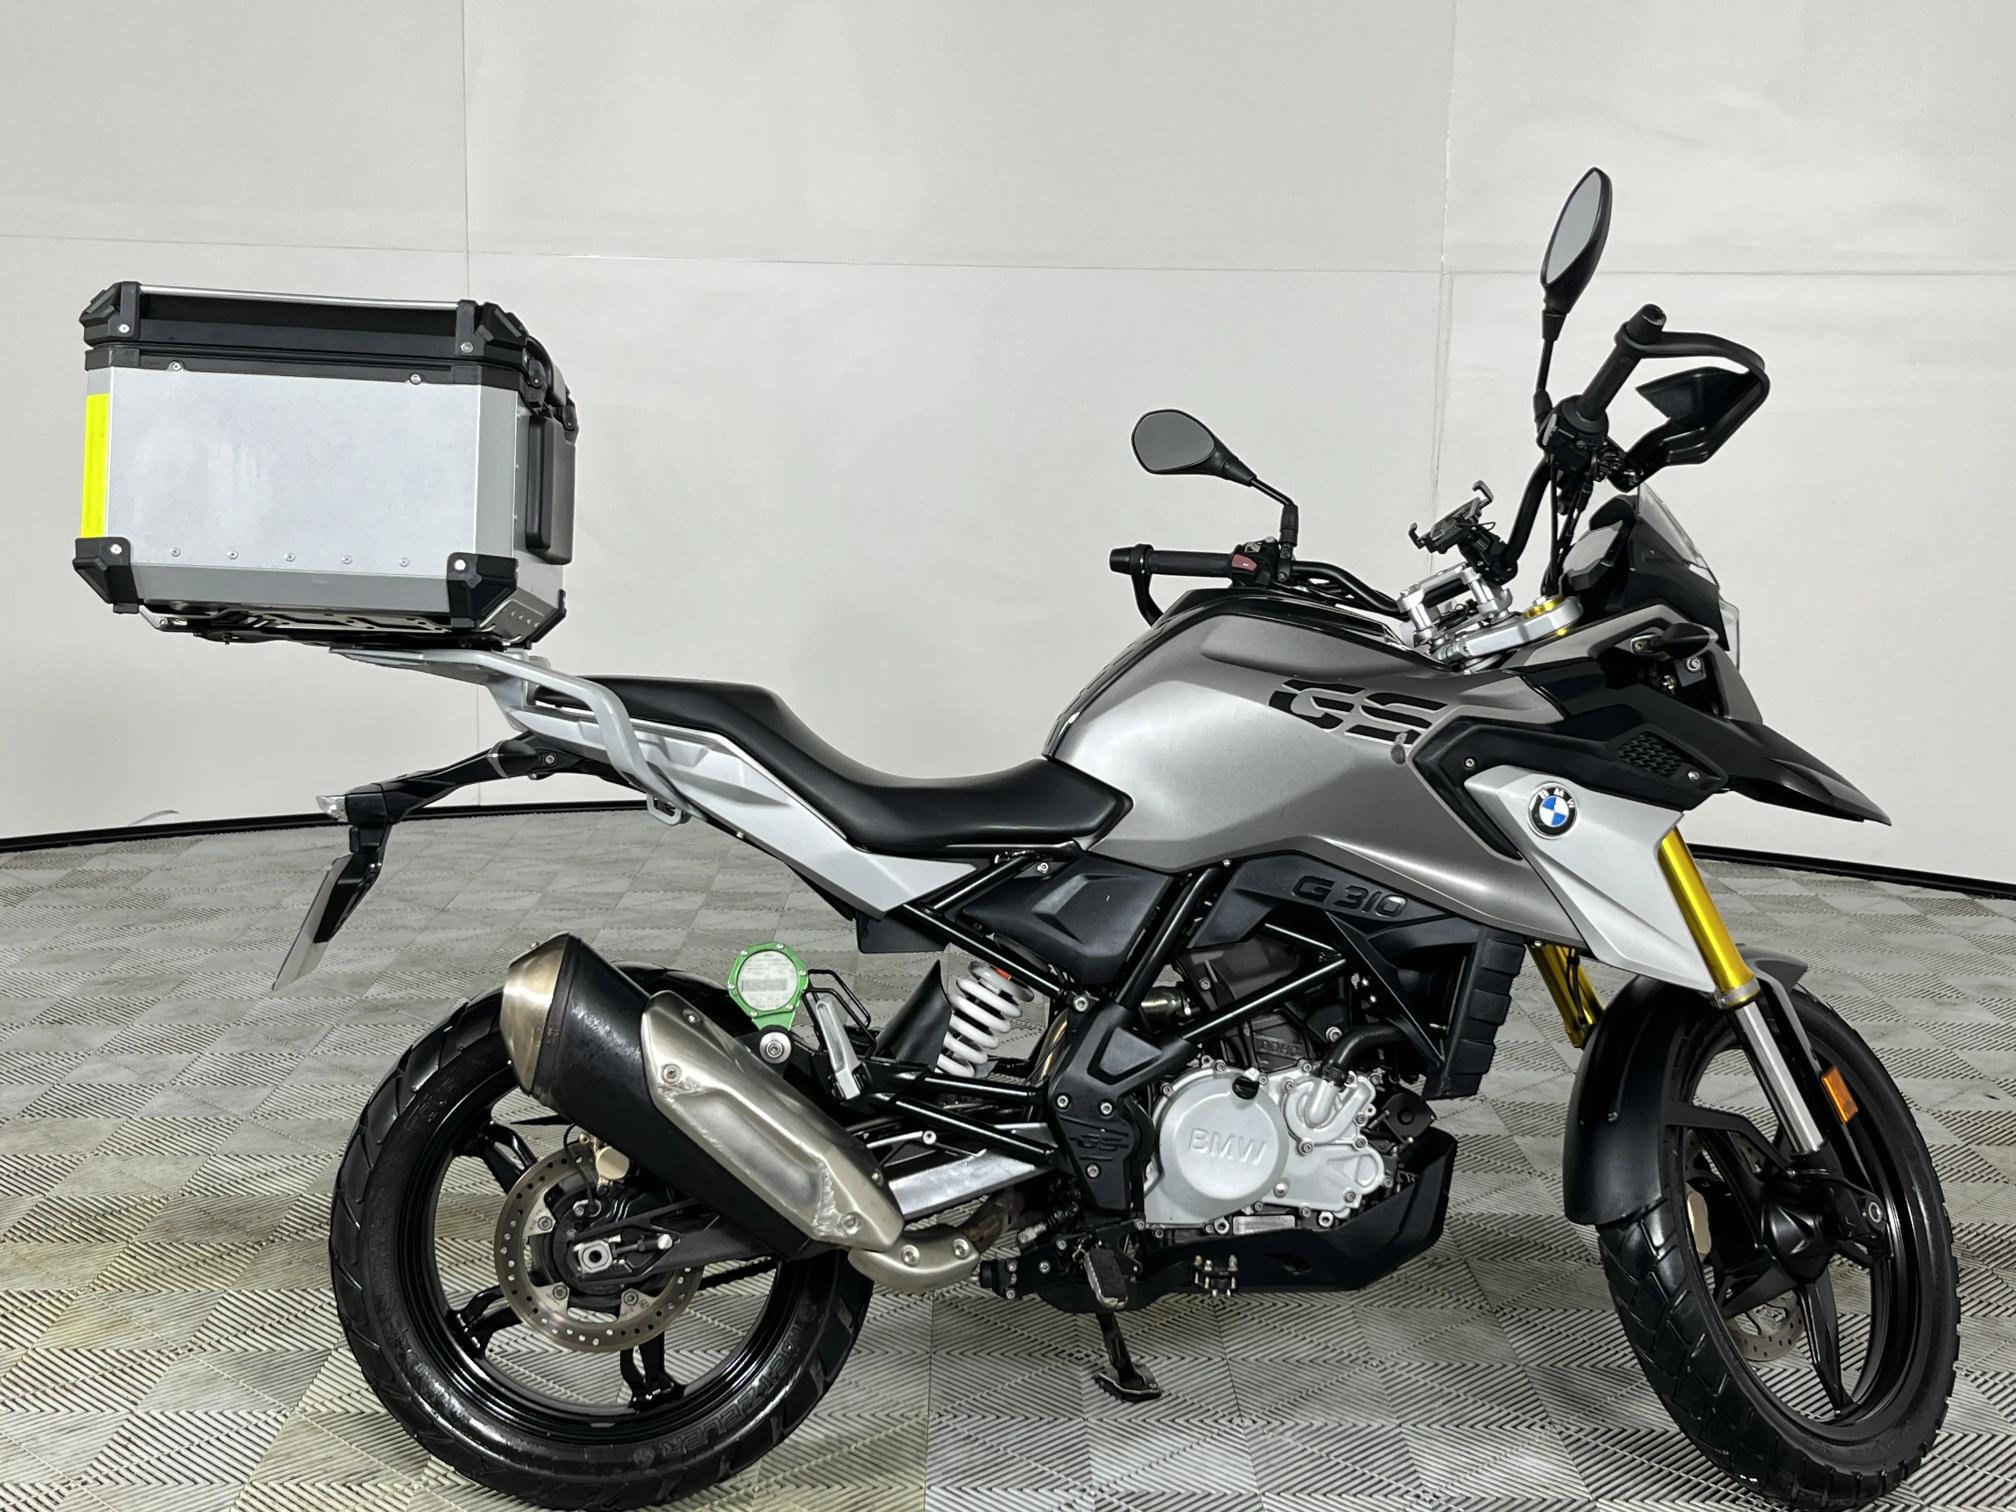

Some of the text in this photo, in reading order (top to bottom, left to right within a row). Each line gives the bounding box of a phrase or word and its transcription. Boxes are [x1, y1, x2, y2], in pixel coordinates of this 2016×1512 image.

[1268, 678, 1448, 747] GS
[1538, 787, 1576, 809] BMW
[1292, 875, 1409, 918] G 310
[1187, 1126, 1268, 1166] BMW
